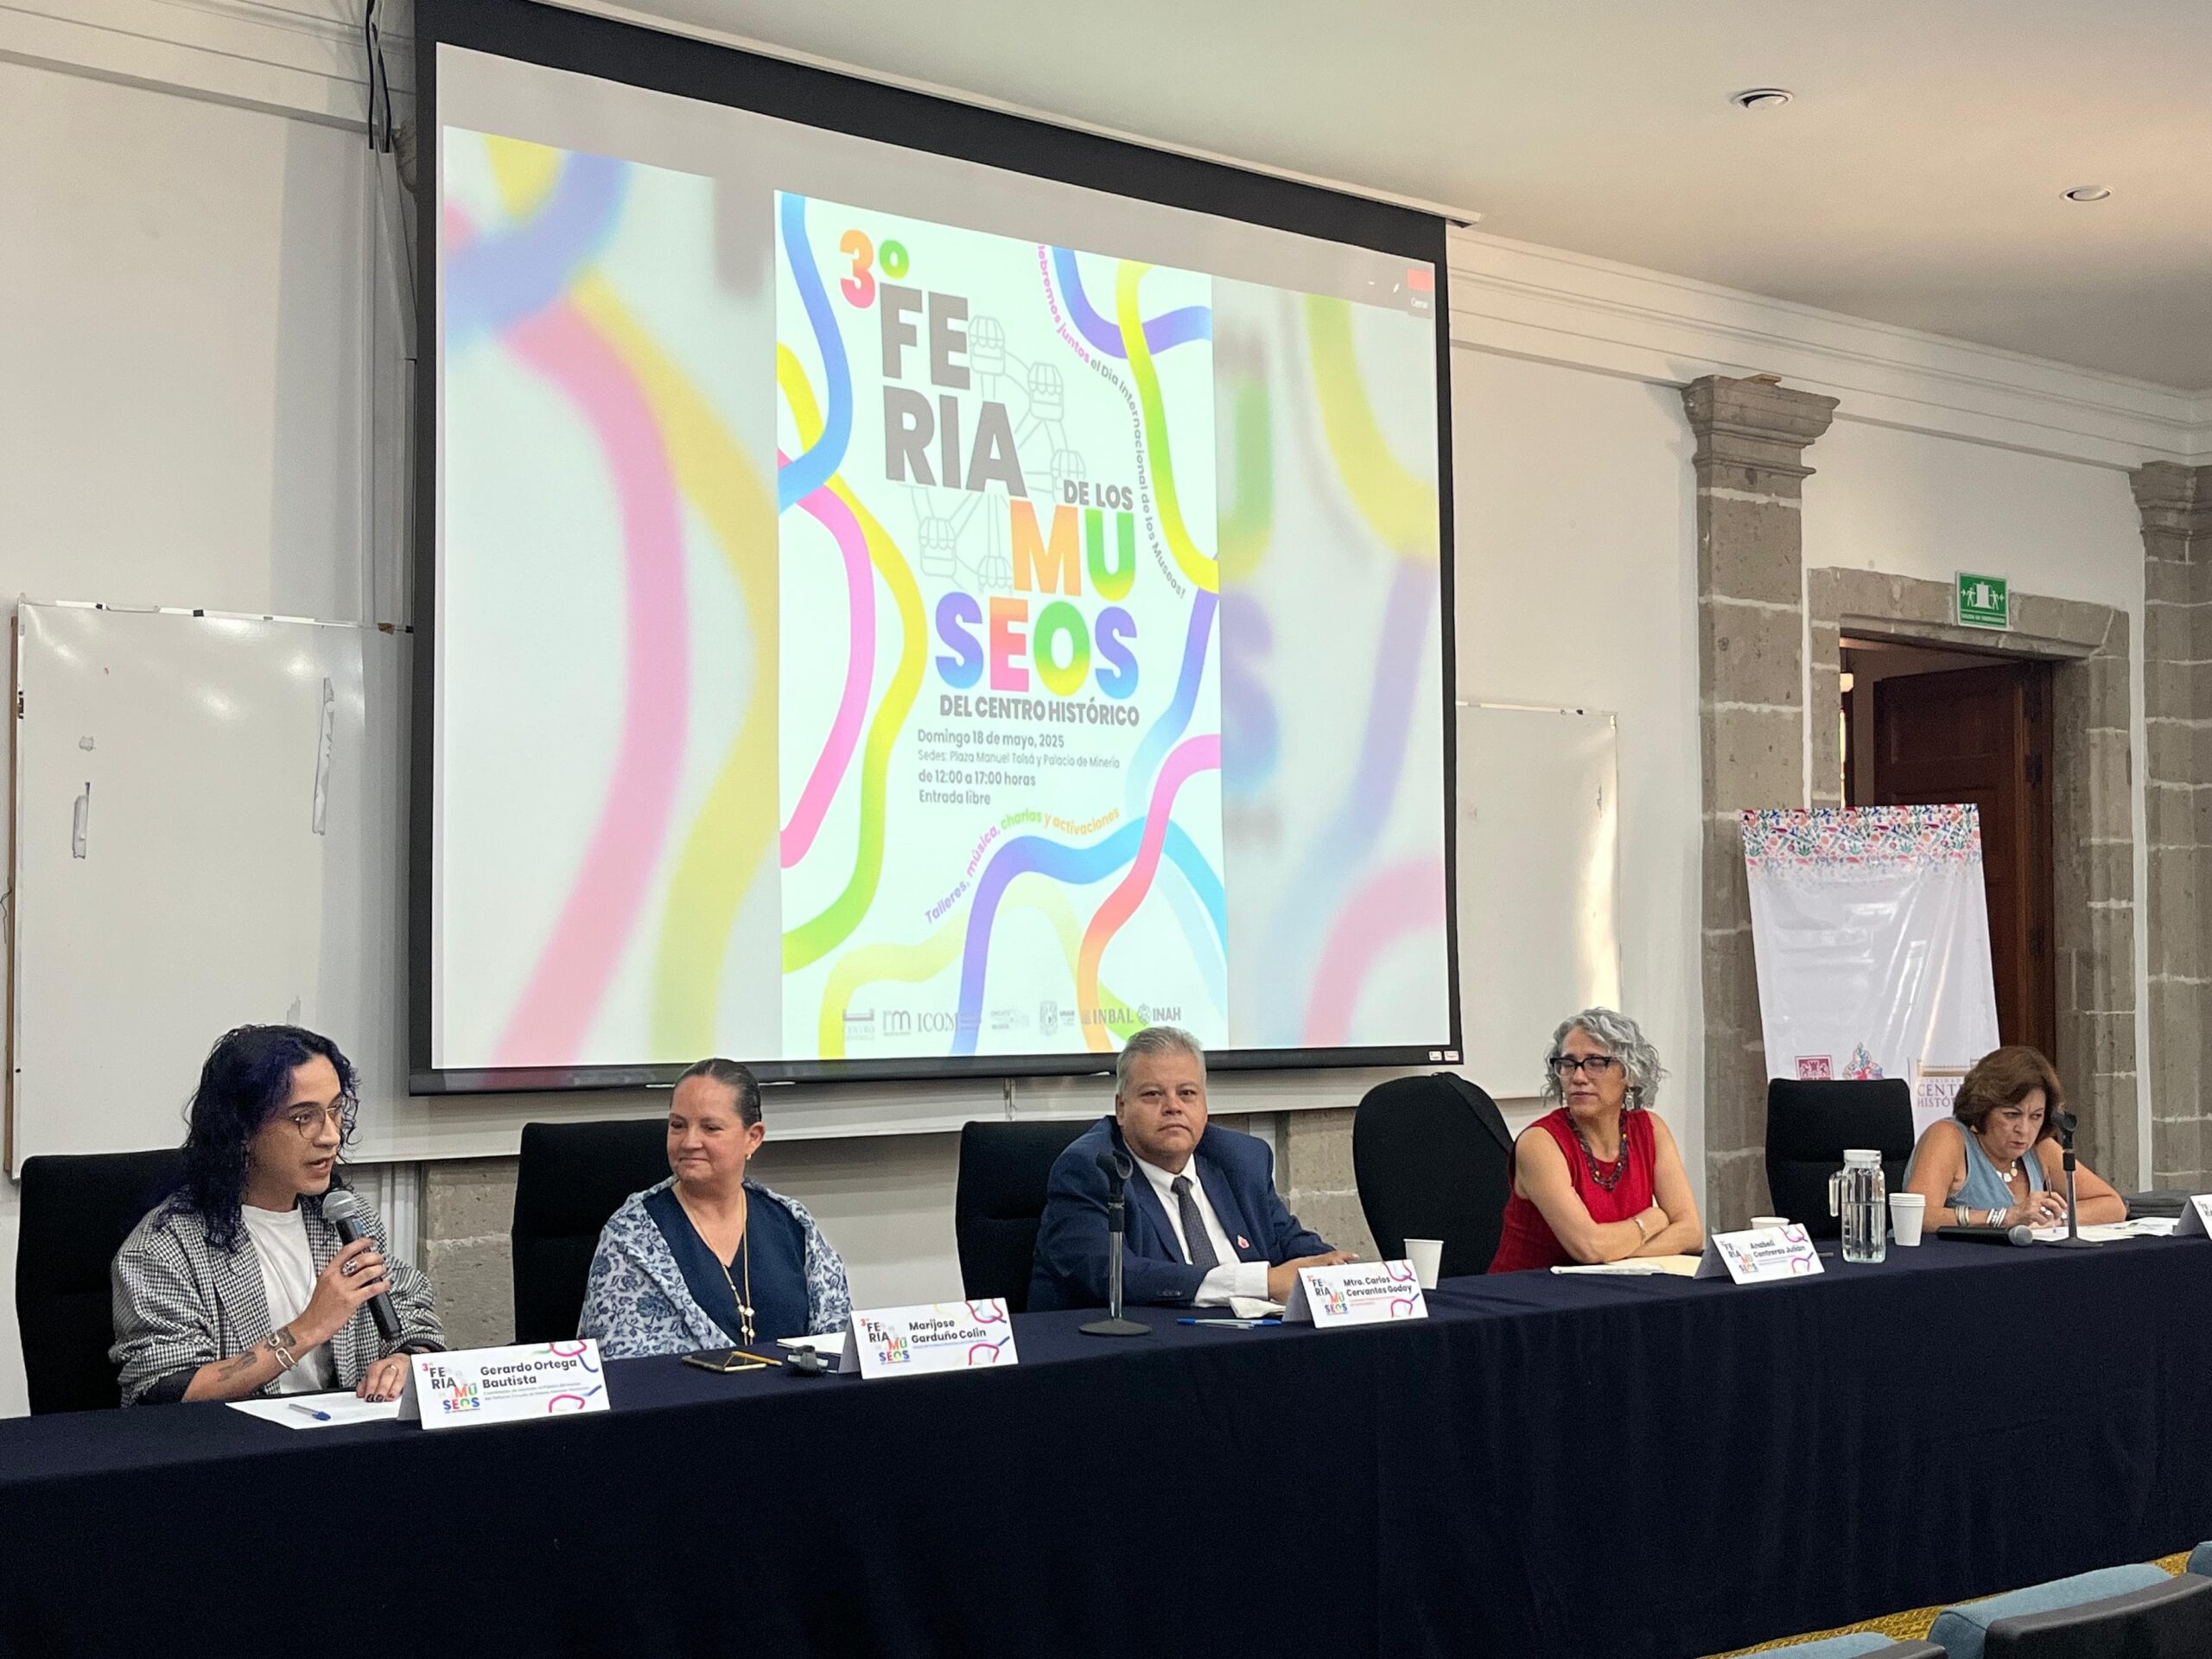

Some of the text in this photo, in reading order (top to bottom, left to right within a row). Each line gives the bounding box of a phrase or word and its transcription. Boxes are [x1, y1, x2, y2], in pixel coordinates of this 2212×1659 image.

[880, 282, 971, 391] FE
[1057, 323, 1090, 364] juntos
[1090, 359, 1101, 372] el
[882, 385, 1028, 499] RIA
[1119, 380, 1148, 490] Internacional
[1063, 480, 1134, 511] DE LOS
[1141, 493, 1150, 513] de
[1145, 517, 1155, 541] los
[1009, 499, 1136, 602] MU
[1152, 543, 1186, 600] Museos!
[935, 591, 1140, 700] SEOS
[939, 694, 1141, 727] DEL CENTRO HISTÓRICO
[918, 728, 1065, 750] Domingo 18 de mayo, 2025
[918, 749, 949, 761] Sedes:
[950, 750, 975, 763] Plaza
[976, 752, 1010, 765] Manuel
[1036, 755, 1042, 767] y
[1043, 754, 1076, 766] Palacio
[1077, 755, 1088, 767] de
[918, 769, 1036, 786] de 12:00 a 17:00 horas
[918, 789, 992, 805] Entrada libre
[925, 880, 970, 925] Talleres,
[1000, 809, 1043, 830] charlas
[1044, 812, 1052, 829] y
[1052, 808, 1121, 836] activaciones
[1093, 1007, 1135, 1025] INBAL
[1152, 1007, 1182, 1022] INAH
[1917, 1084, 1958, 1096] CENT
[1917, 1096, 1954, 1108] HISTÓ
[1344, 1275, 1391, 1287] Mtro. Carlos
[1346, 1284, 1413, 1297] Cervantes Godoy
[867, 1321, 881, 1332] FE
[909, 1318, 955, 1332] Marijose
[868, 1332, 891, 1343] RIA
[912, 1329, 958, 1344] Garduño
[878, 1350, 911, 1362] SEOS
[429, 1366, 447, 1378] FE
[480, 1358, 578, 1376] Gerardo Ortega
[431, 1377, 457, 1390] RIA
[482, 1374, 537, 1389] Bautista
[442, 1396, 481, 1412] SEOS
